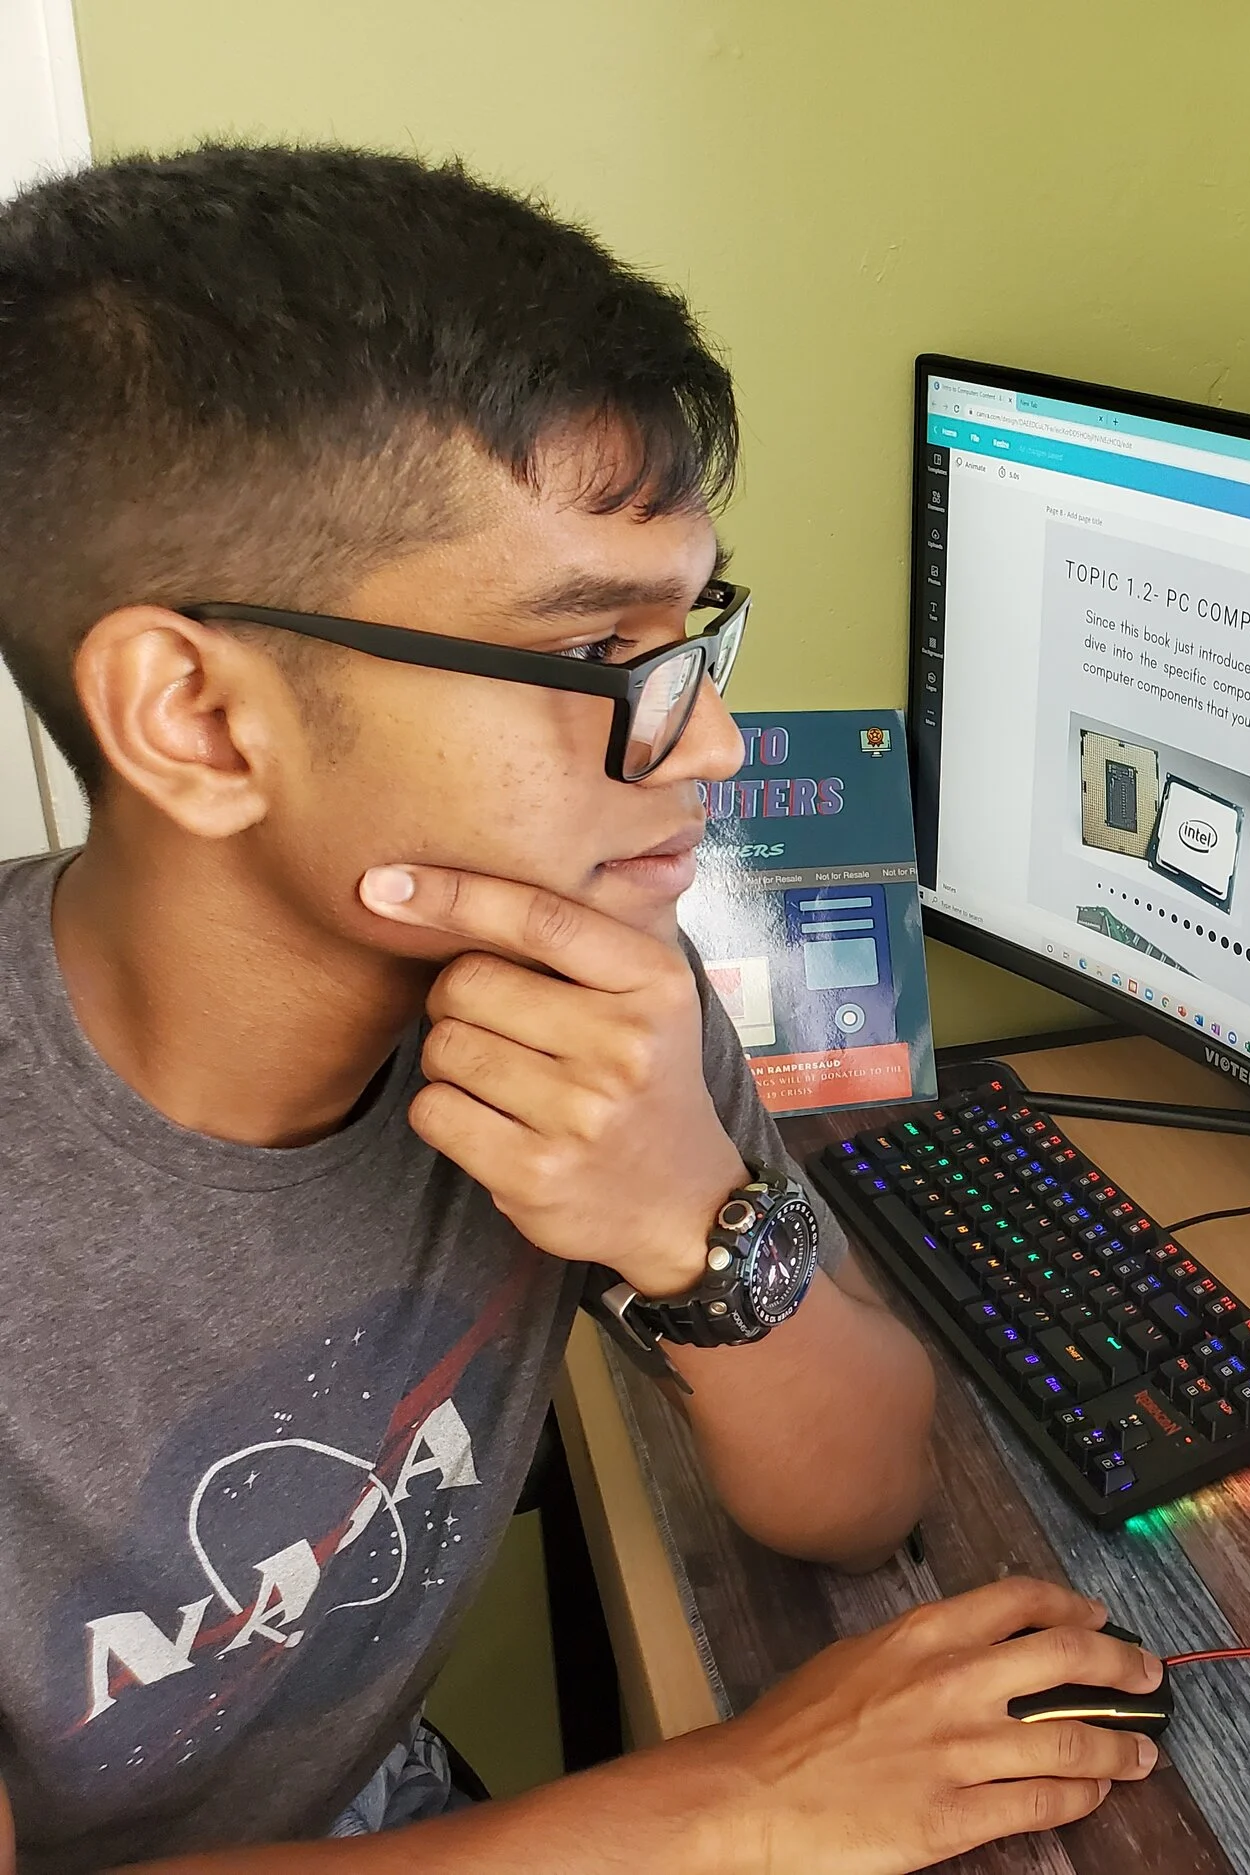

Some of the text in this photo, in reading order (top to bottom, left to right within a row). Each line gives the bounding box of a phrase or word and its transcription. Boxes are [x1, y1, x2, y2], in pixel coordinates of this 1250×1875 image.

[1065, 559, 1119, 591] TOPIC
[1127, 577, 1159, 602] 1.2-
[1166, 588, 1189, 612] PC
[1085, 609, 1116, 631] Since
[1120, 619, 1139, 638] this
[1143, 624, 1171, 648] book
[1173, 637, 1194, 656] just
[1084, 633, 1107, 653] dive
[1112, 643, 1134, 661] into
[1139, 650, 1157, 669] the
[1163, 663, 1207, 686] specific
[775, 874, 803, 884] Resale
[815, 872, 830, 882] Not
[831, 871, 842, 880] for
[843, 870, 870, 880] Resale
[882, 868, 897, 878] Not
[898, 868, 908, 877] for
[767, 1060, 841, 1074] RAMPERSAUD
[779, 1076, 801, 1085] WILL
[821, 1070, 866, 1081] DONATED
[870, 1067, 882, 1076] TO
[780, 1087, 813, 1097] CRISIS
